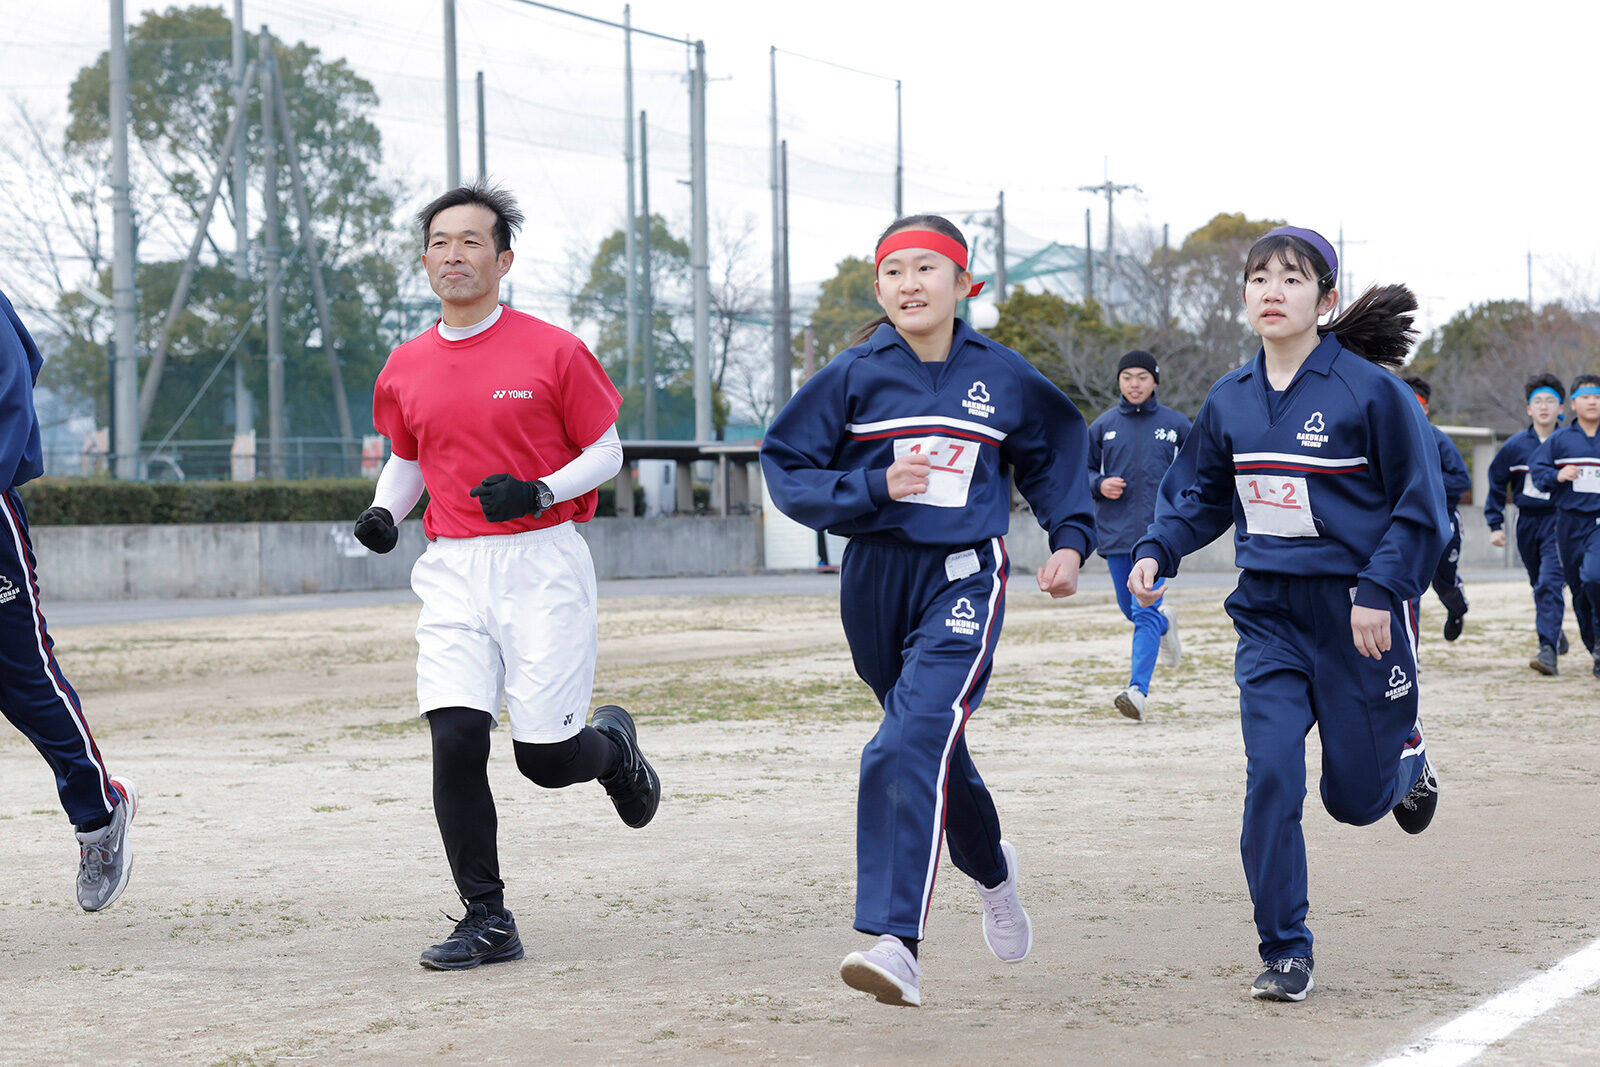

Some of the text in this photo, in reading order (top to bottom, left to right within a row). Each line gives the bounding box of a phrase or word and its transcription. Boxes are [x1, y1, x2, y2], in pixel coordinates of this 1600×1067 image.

[508, 390, 533, 399] YONEX
[962, 399, 995, 414] RAKUNAN
[1296, 432, 1329, 443] RAKUNAN
[945, 618, 980, 631] RAKUNAN
[1385, 680, 1412, 698] RAKUNAN
